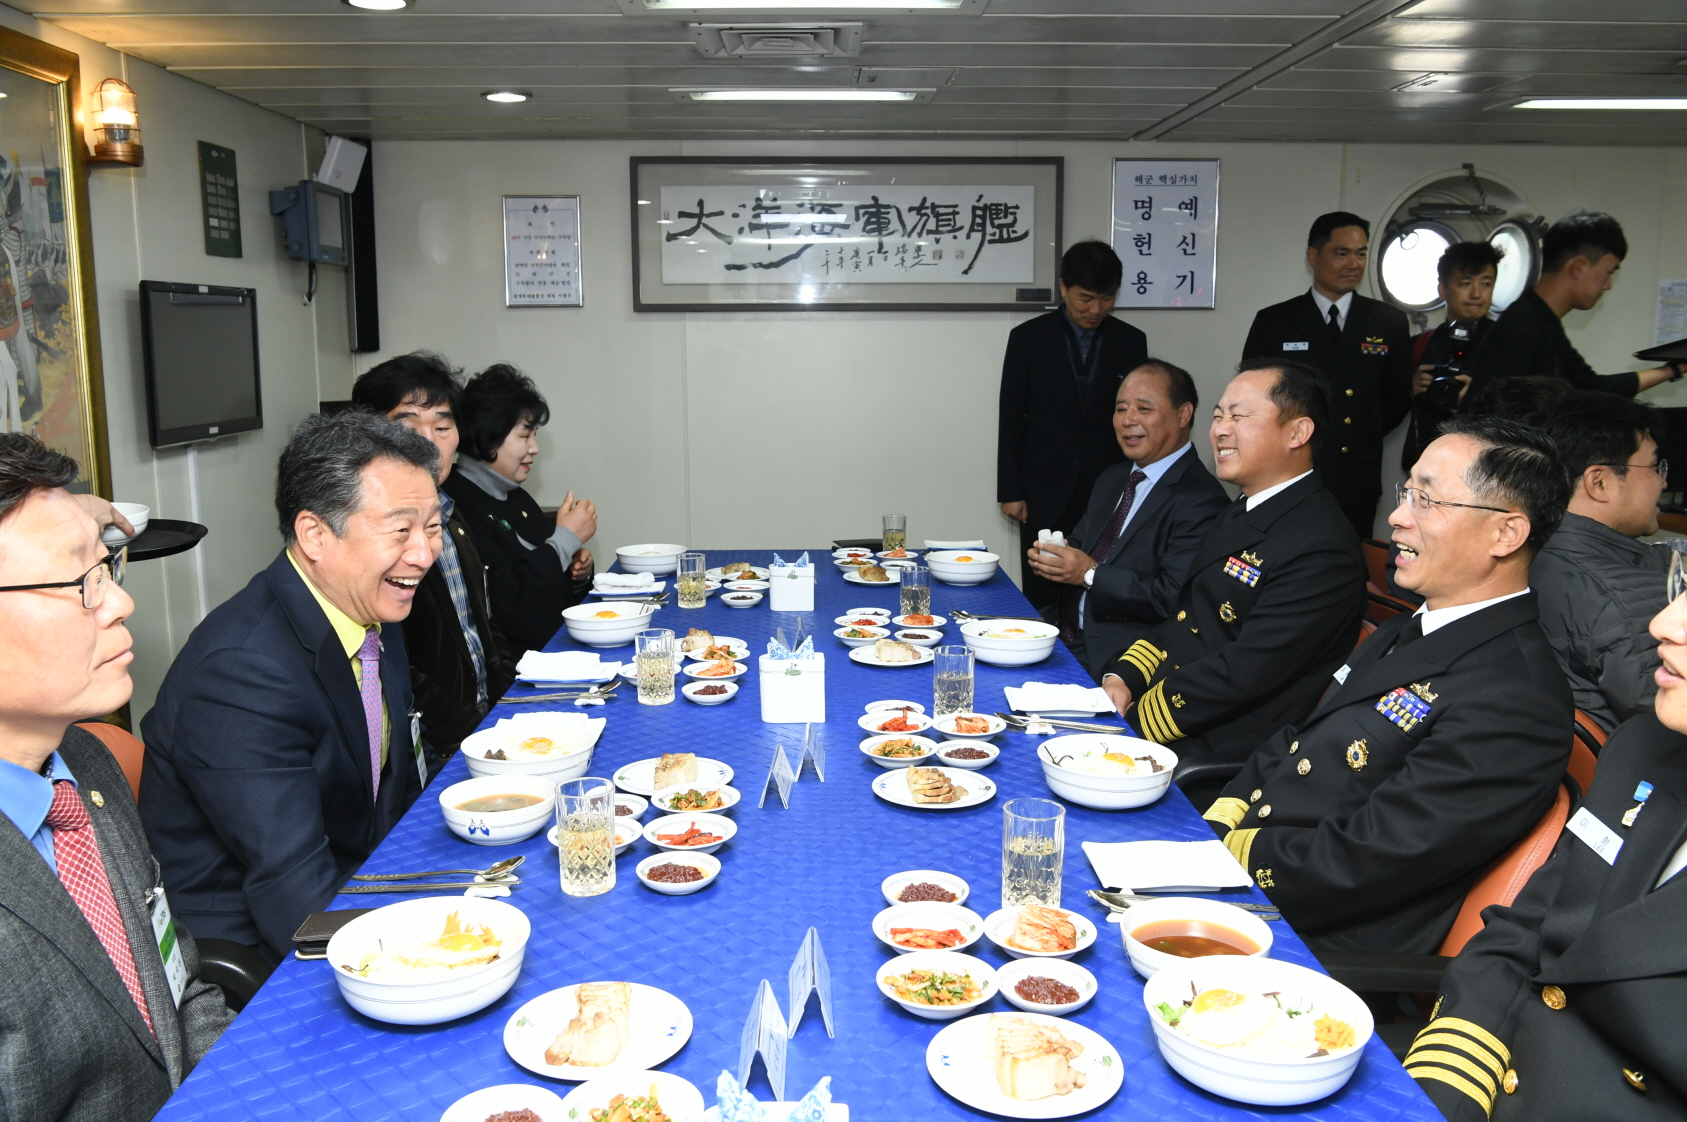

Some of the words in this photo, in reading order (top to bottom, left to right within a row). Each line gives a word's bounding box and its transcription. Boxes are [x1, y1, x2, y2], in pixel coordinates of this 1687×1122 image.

[1134, 174, 1154, 185] 해군
[1158, 174, 1198, 185] 핵심가치
[1133, 196, 1153, 221] 명
[1132, 233, 1152, 256] 헌
[1176, 232, 1196, 256] 신
[1131, 270, 1153, 295] 용
[1174, 270, 1195, 295] 기
